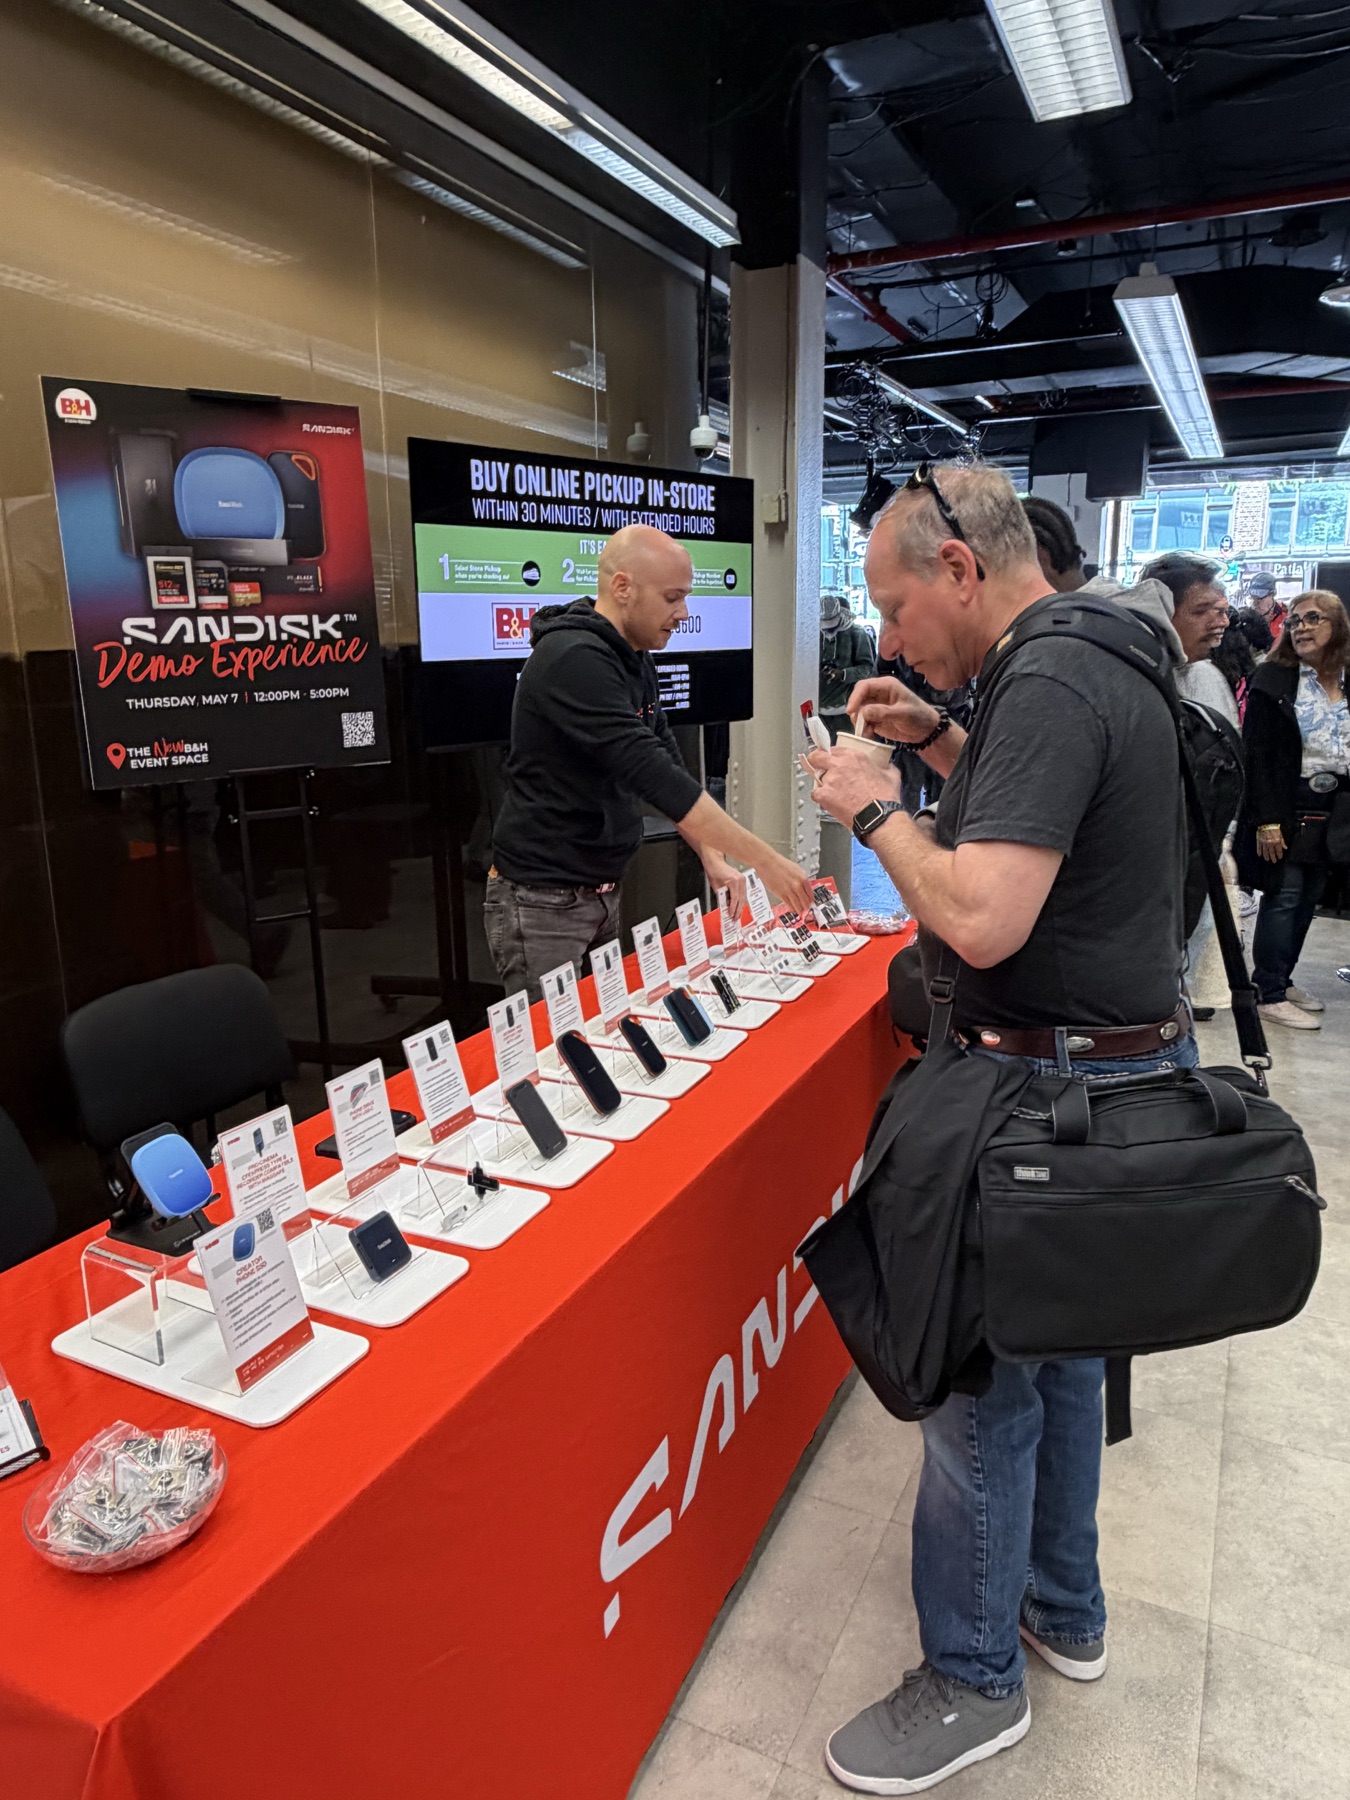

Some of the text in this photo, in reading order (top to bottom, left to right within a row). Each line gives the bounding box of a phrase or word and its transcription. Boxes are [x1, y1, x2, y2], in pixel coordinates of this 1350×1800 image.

[60, 398, 92, 416] B&H
[470, 459, 716, 512] BUY ONLINE PICKUP IN-STORE
[472, 497, 519, 522] WITHIN
[521, 501, 537, 523] 30
[540, 503, 591, 527] MINUTES
[601, 508, 629, 529] WITH
[631, 511, 681, 533] EXTENDED
[683, 516, 716, 535] HOURS
[580, 539, 596, 555] IT'S
[439, 553, 450, 581] 1
[562, 558, 575, 583] 2
[496, 607, 537, 639] B&H
[93, 636, 369, 689] Demo Experience
[125, 694, 200, 710] THURSDAY,
[201, 693, 229, 706] MAY
[231, 693, 239, 704] 7
[254, 690, 300, 702] 12:00PM
[309, 687, 350, 699] 5:00PM
[126, 737, 209, 758] THE New B&H
[130, 753, 210, 769] EVENT SPACE
[235, 1268, 256, 1285] PHONE
[236, 1255, 263, 1276] CREATOR
